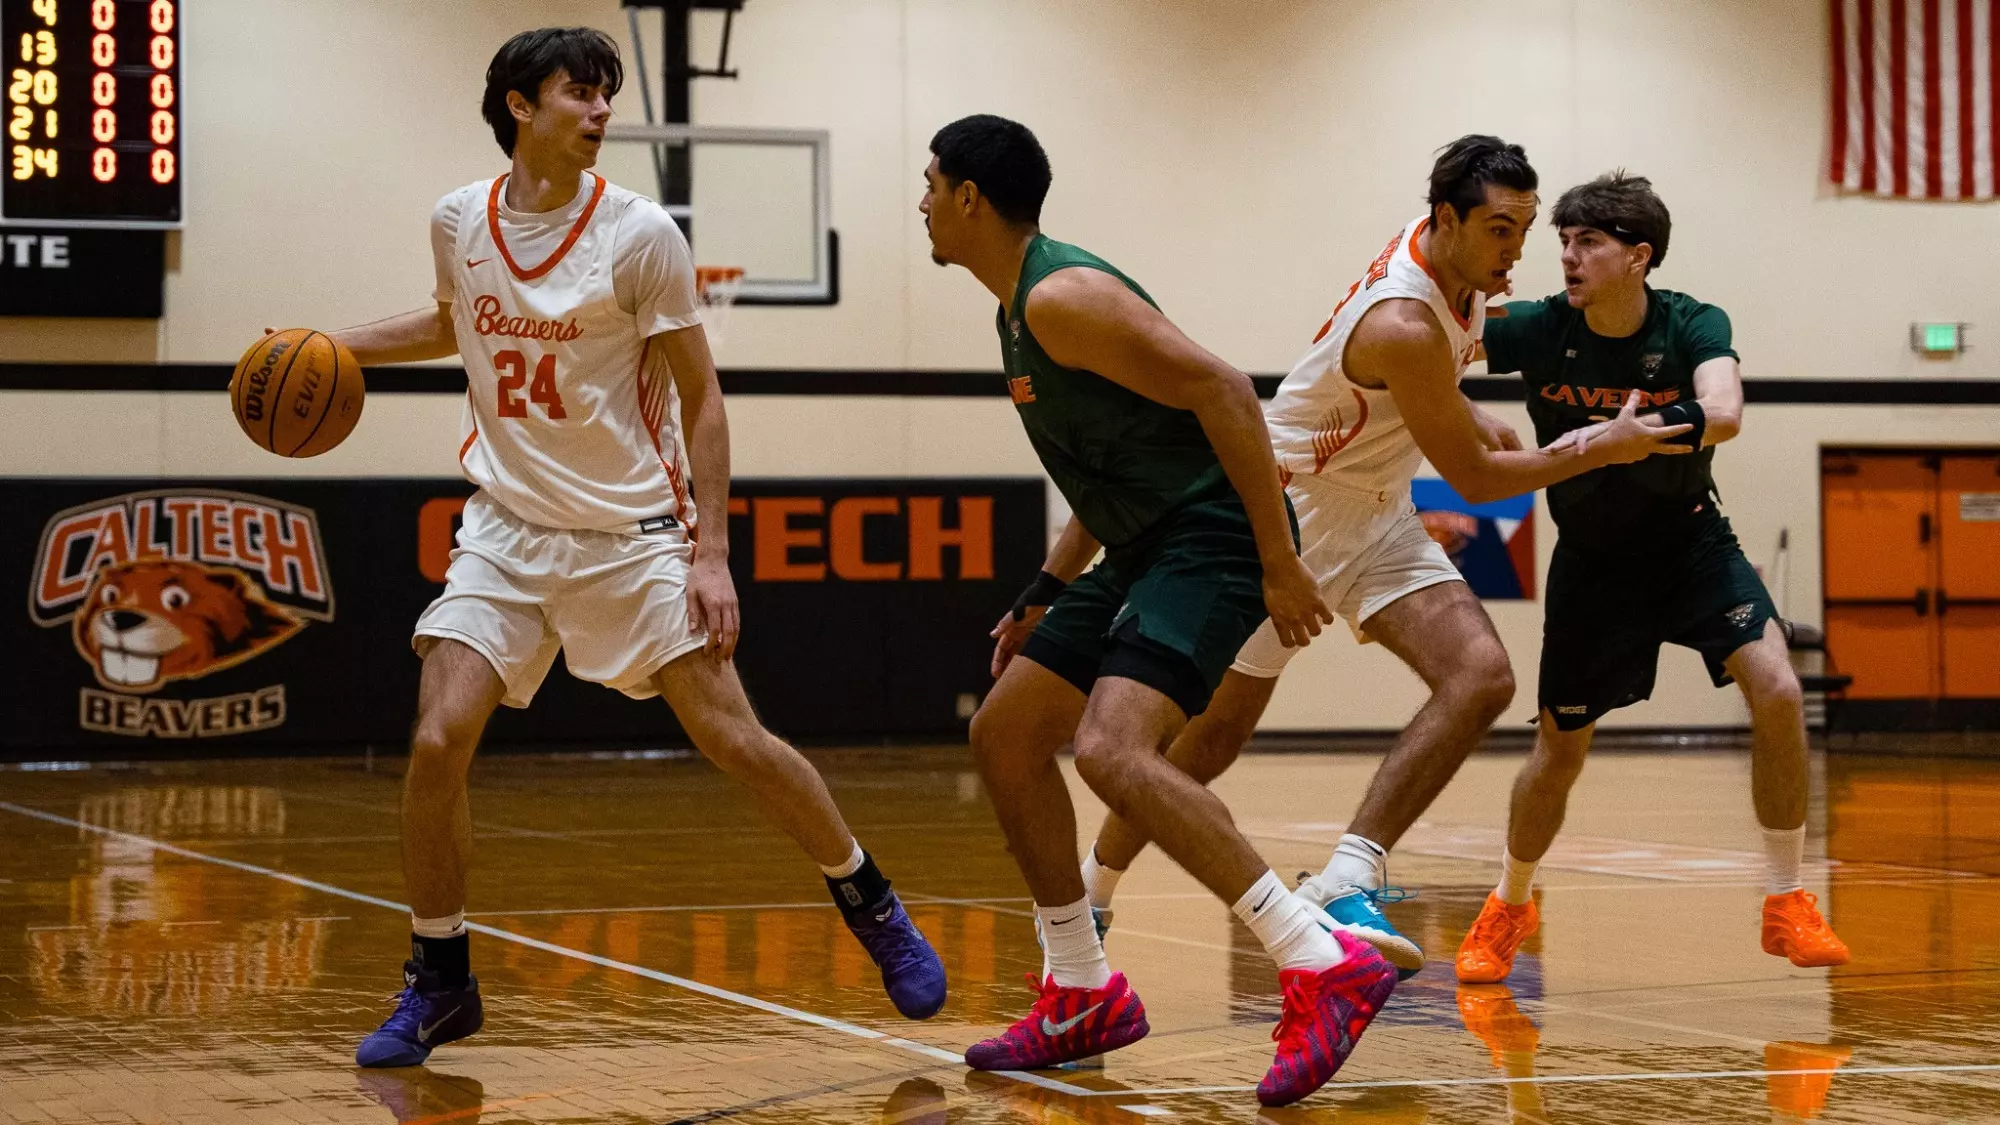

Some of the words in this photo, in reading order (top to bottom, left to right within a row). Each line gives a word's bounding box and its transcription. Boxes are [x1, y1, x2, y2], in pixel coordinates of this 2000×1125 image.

[33, 0, 57, 26] 4
[92, 0, 115, 31] 0
[151, 0, 173, 33] 0
[21, 31, 57, 65] 13
[92, 33, 115, 67] 0
[151, 35, 174, 69] 0
[9, 69, 57, 105] 20
[93, 72, 116, 106] 0
[151, 74, 174, 108] 0
[9, 105, 58, 141] 21
[93, 108, 116, 142] 0
[151, 110, 174, 144] 0
[13, 145, 58, 180] 34
[93, 147, 117, 181] 0
[152, 149, 175, 183] 0
[0, 235, 70, 268] TE
[474, 295, 584, 342] Beavers
[246, 341, 290, 421] Wilson
[493, 350, 567, 419] 24
[37, 498, 326, 608] CALTECH
[81, 685, 285, 737] BEAVERS
